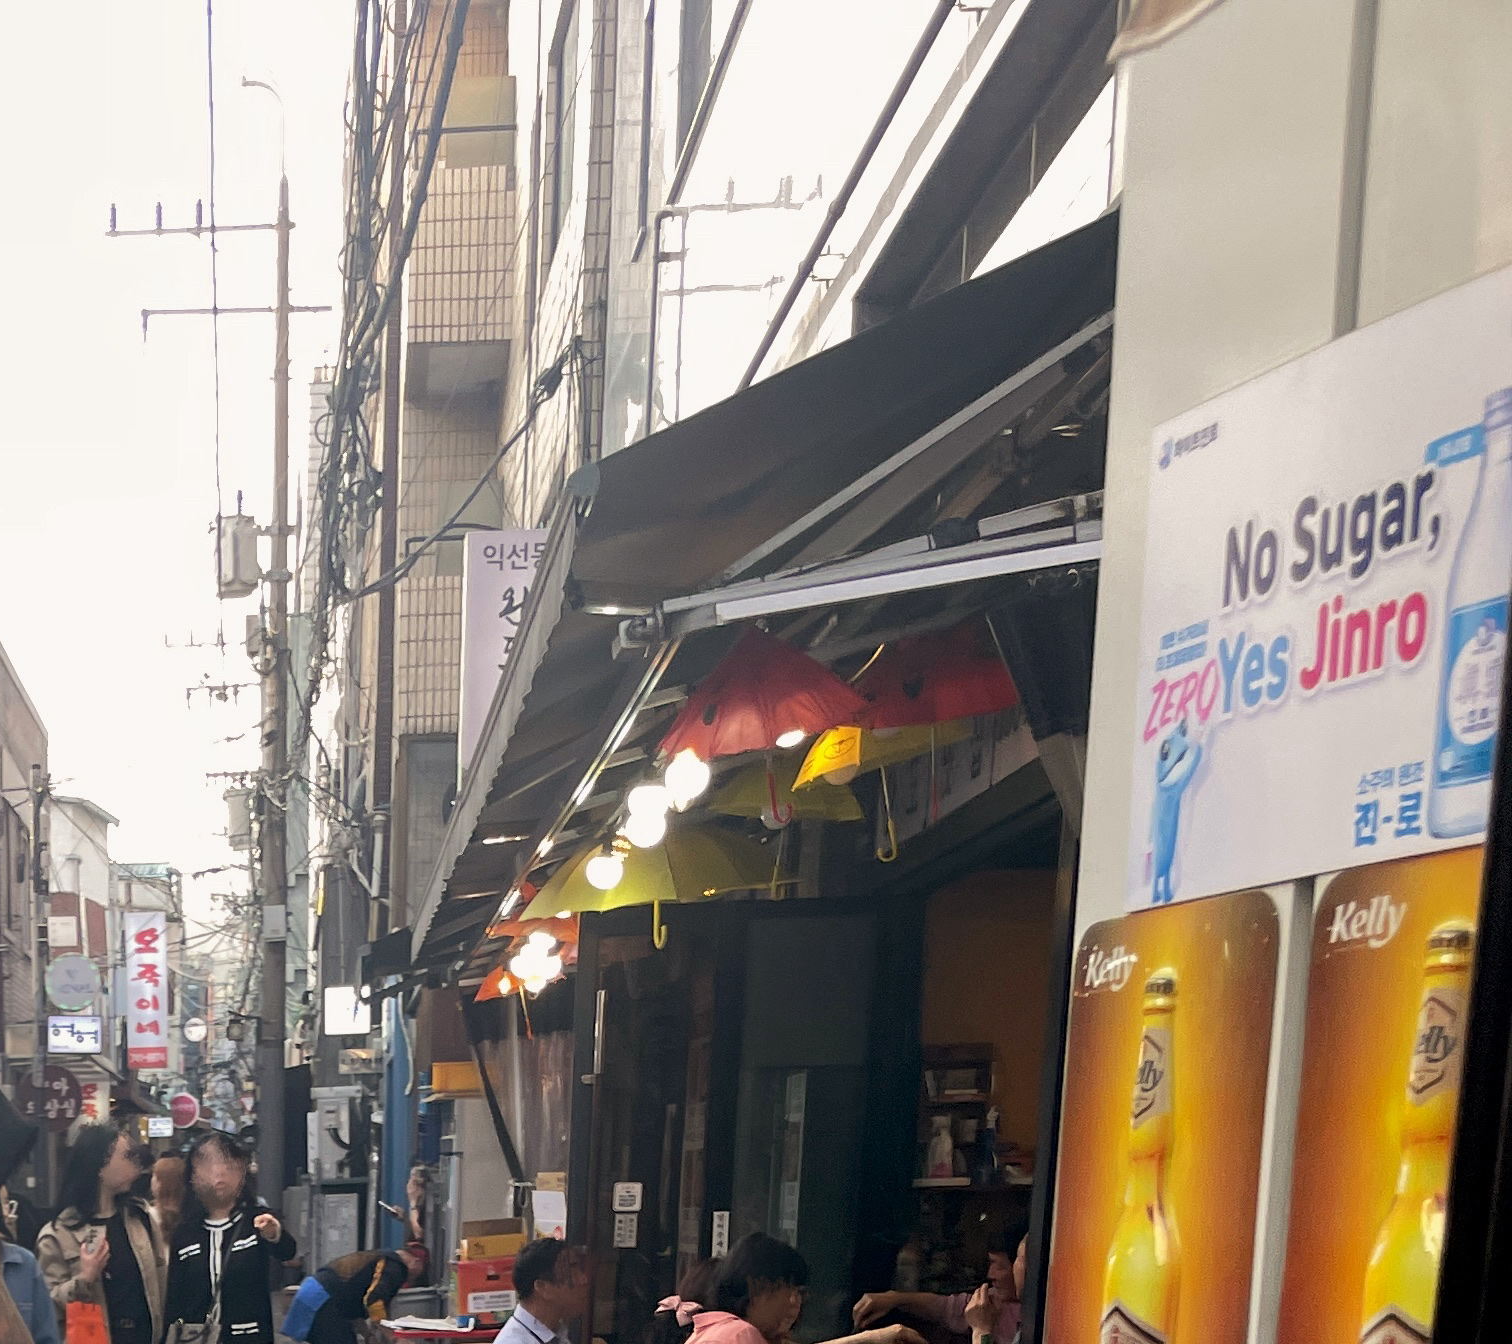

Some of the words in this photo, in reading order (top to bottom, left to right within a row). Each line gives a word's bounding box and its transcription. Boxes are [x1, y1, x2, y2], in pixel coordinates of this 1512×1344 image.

[1222, 519, 1278, 608] No
[1289, 470, 1441, 582] Sugar,
[1143, 658, 1220, 742] ZERO
[1219, 631, 1289, 714] Yes
[1299, 591, 1427, 690] Jinro
[1328, 894, 1408, 949] Kelly
